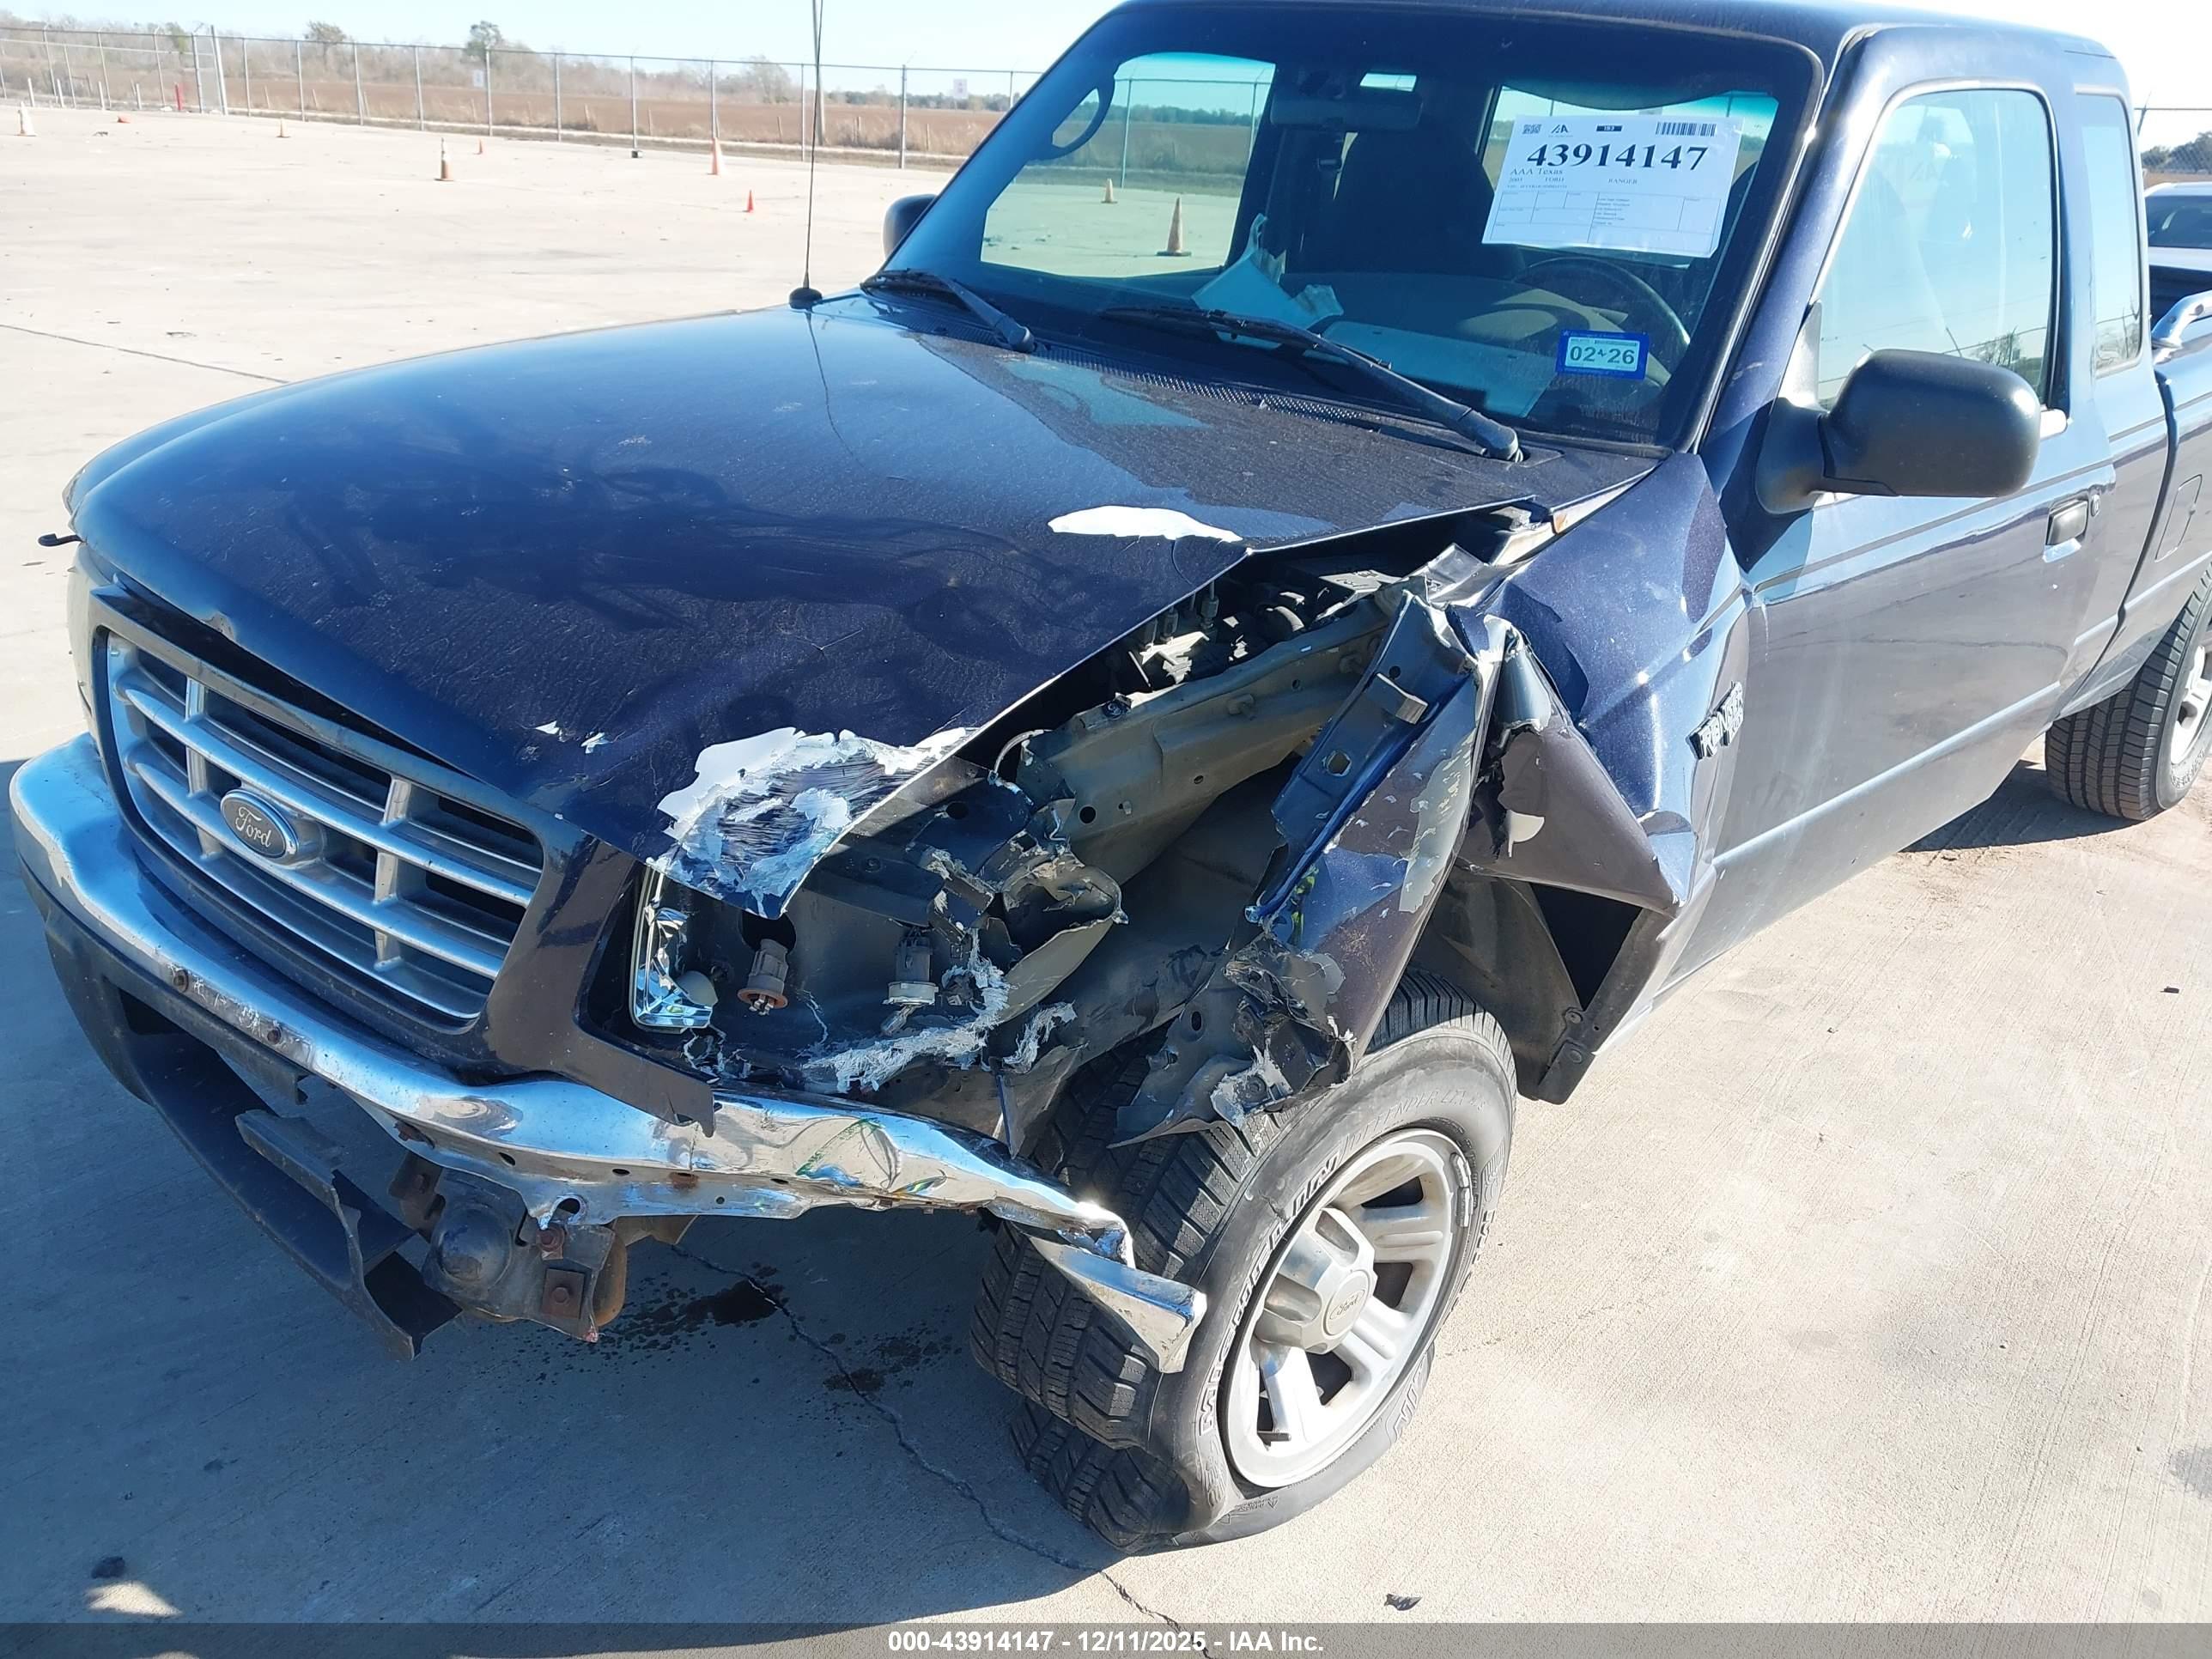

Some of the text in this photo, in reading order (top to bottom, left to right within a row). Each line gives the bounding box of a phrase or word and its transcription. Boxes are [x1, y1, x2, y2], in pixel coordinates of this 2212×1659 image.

[1527, 143, 1709, 170] 43914147
[1537, 167, 1564, 176] Texas
[234, 806, 272, 848] Ford
[1336, 1292, 1359, 1316] Ford
